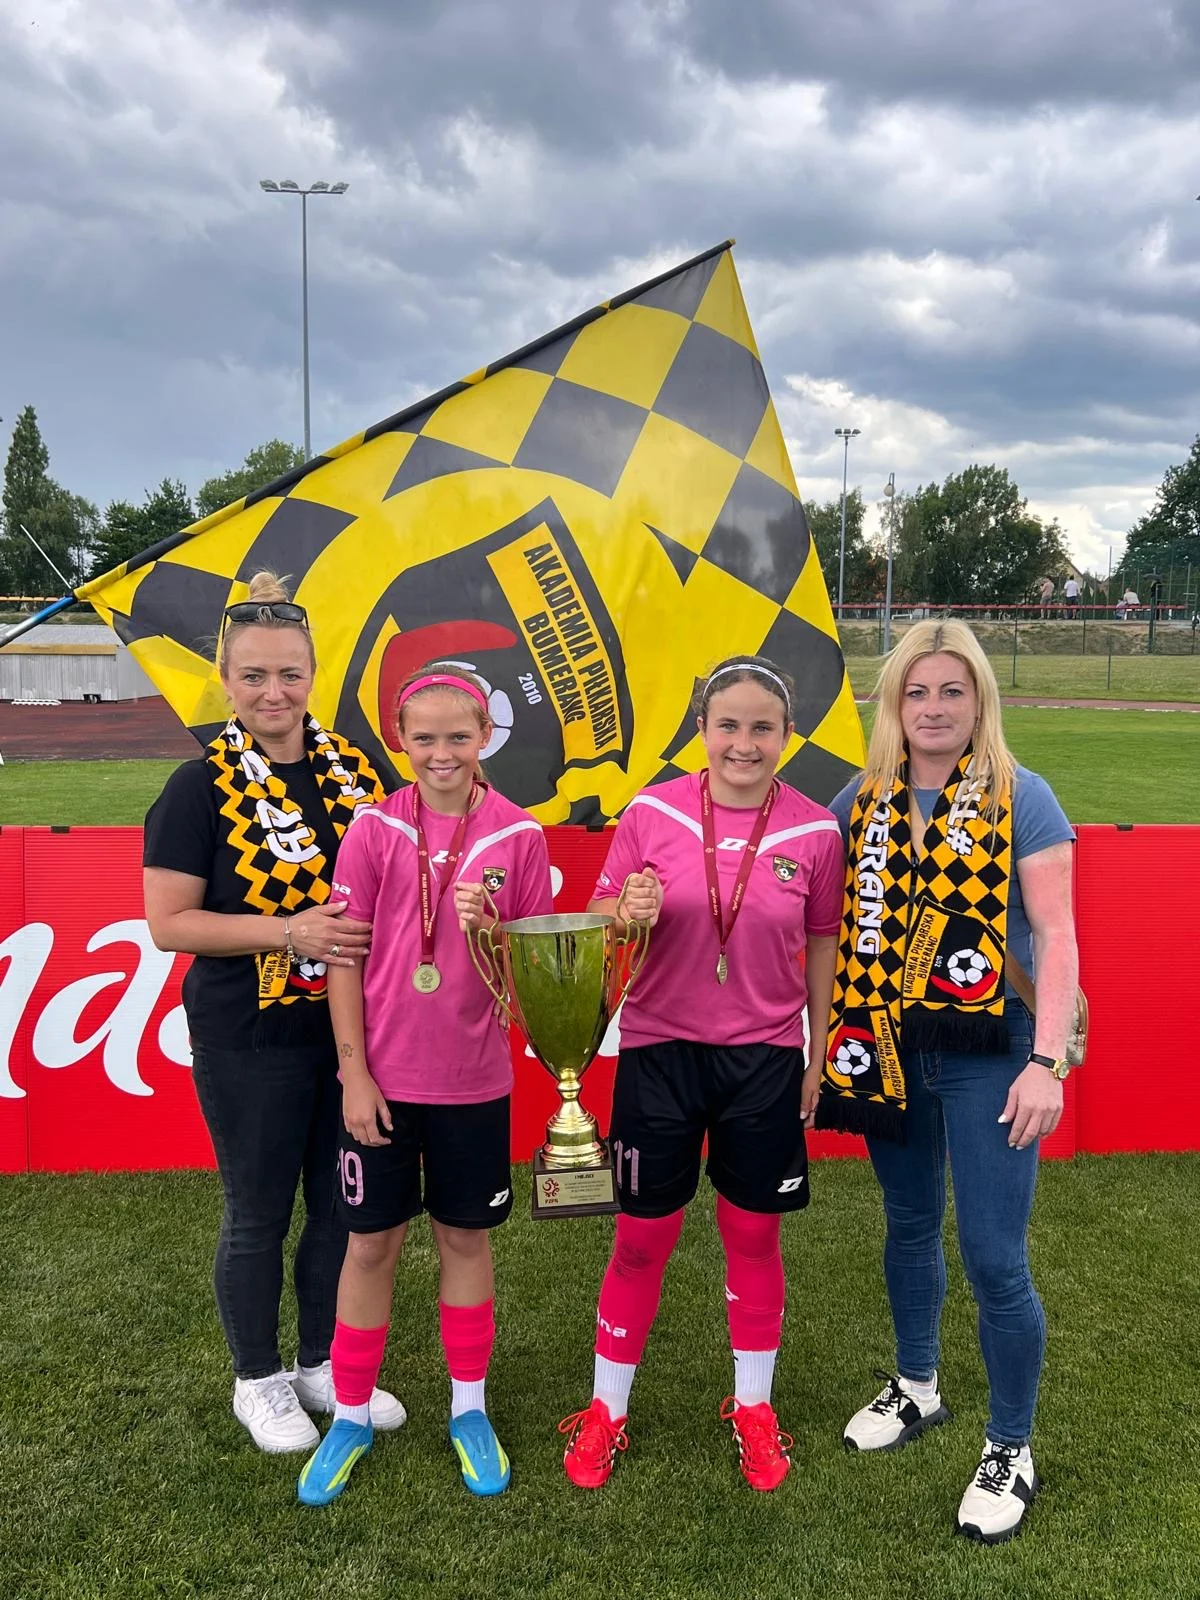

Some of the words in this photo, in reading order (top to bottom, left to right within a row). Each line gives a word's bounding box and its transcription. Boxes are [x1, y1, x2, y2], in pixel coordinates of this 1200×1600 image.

[523, 542, 598, 660] AKADEMIA
[518, 672, 544, 706] 2010
[523, 611, 586, 727] BUMERANG
[911, 913, 935, 956] PIŁKARSKA
[260, 959, 278, 994] AKADEMIA
[904, 955, 919, 994] AKADEMIA
[917, 935, 938, 979] BUMERANG
[879, 1016, 893, 1057] AKADEMIA
[614, 1139, 640, 1195] 11
